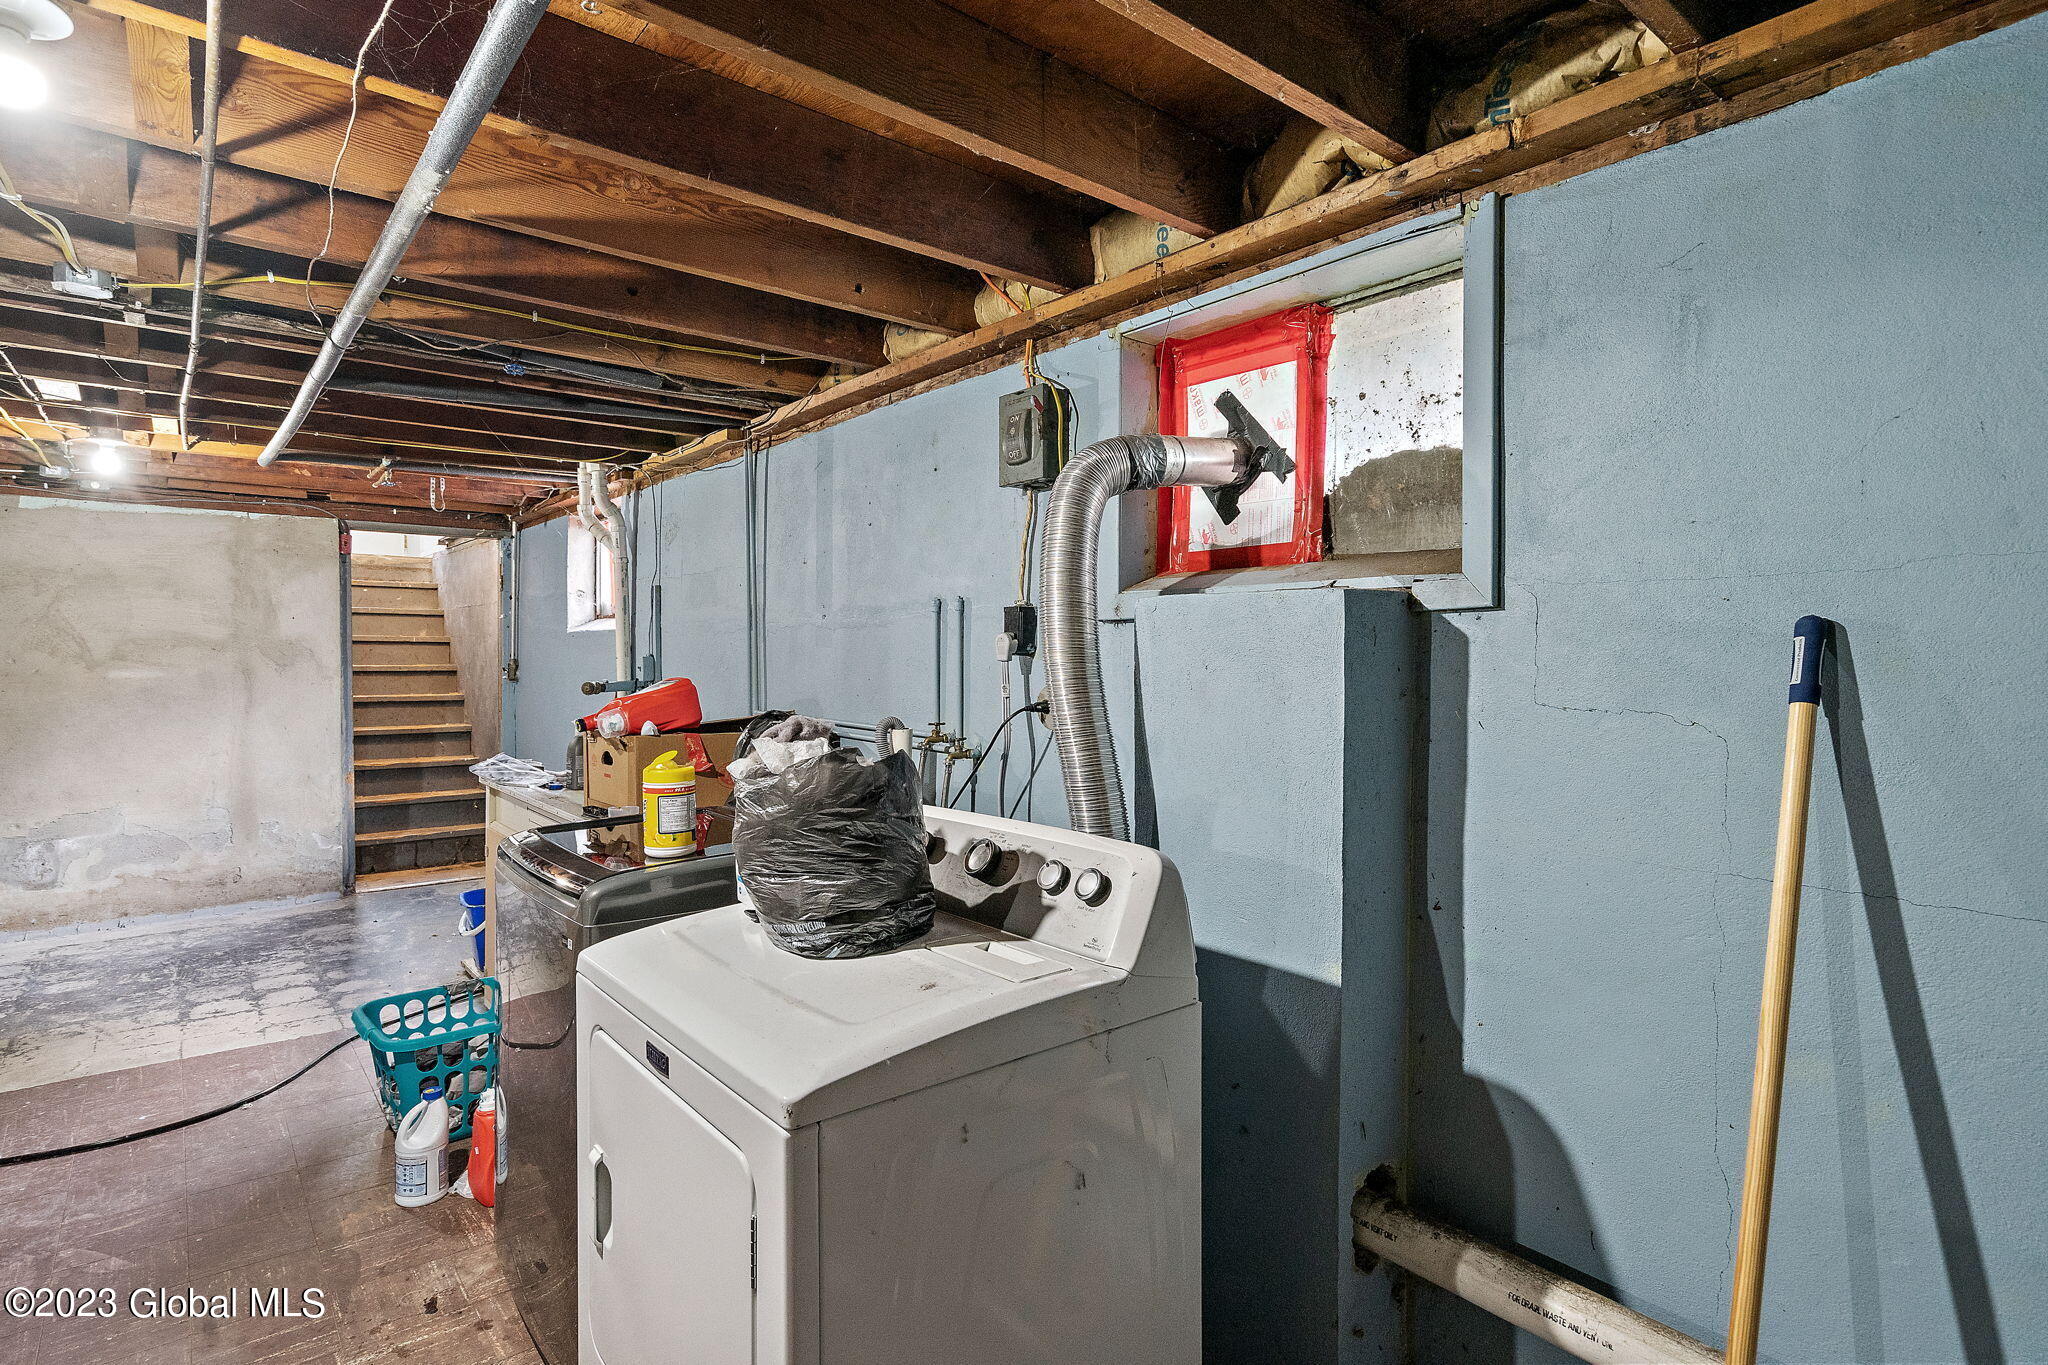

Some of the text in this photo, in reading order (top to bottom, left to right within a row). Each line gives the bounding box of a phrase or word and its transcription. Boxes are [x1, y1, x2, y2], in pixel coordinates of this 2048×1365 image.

[1010, 415, 1020, 423] ON
[1009, 449, 1020, 459] OFF
[1543, 1308, 1567, 1328] WASTE
